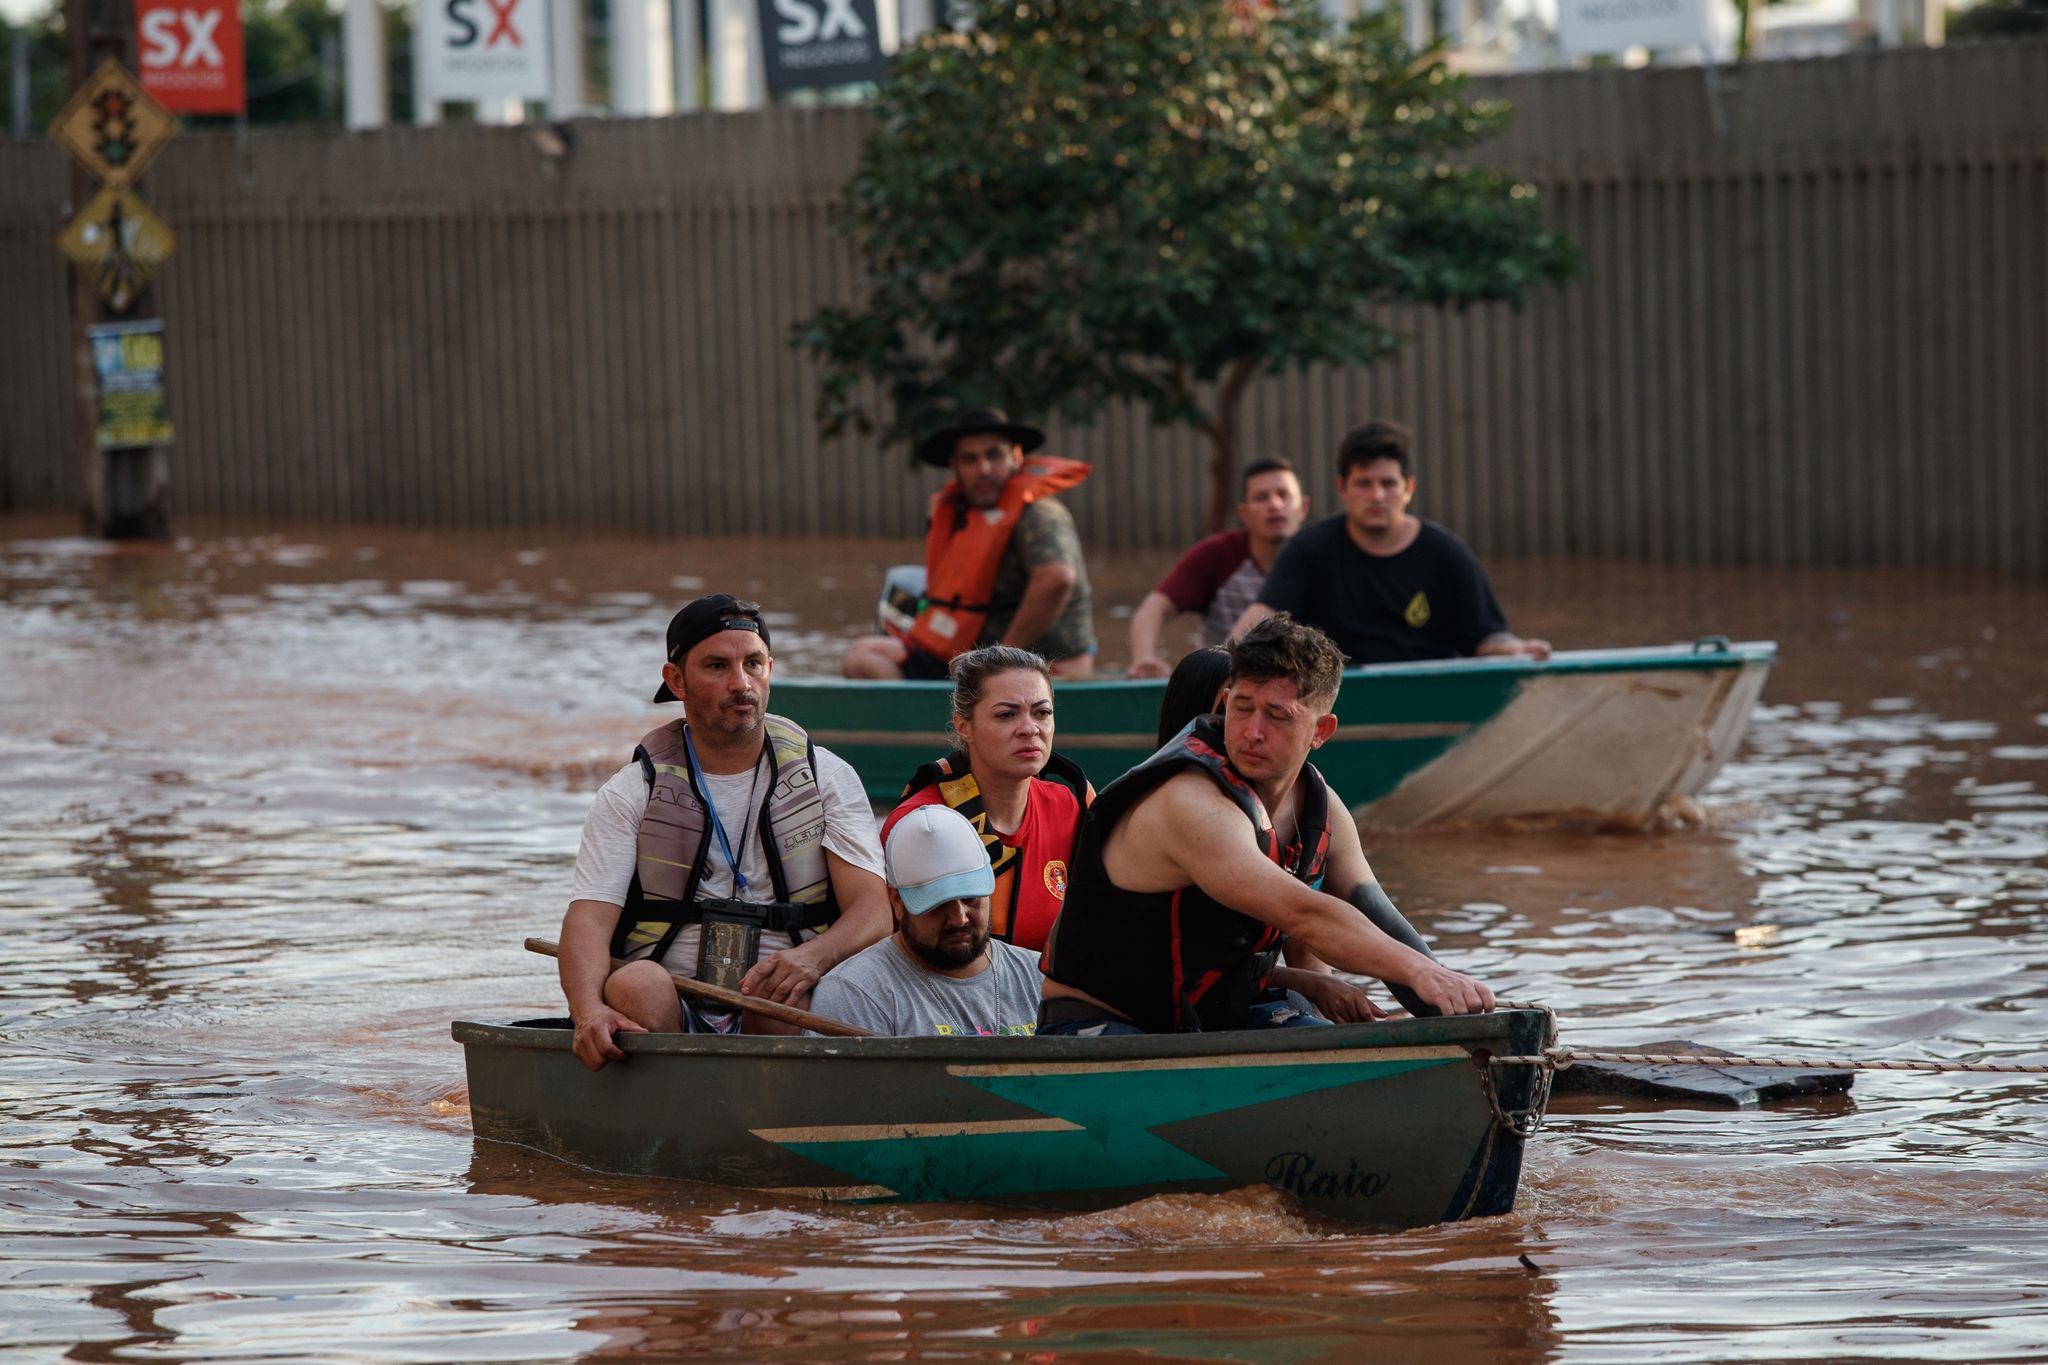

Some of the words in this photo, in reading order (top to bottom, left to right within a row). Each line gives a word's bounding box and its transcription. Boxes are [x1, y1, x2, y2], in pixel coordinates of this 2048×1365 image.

[141, 8, 223, 68] SX
[447, 0, 524, 49] SX
[777, 0, 866, 43] SX
[1265, 1152, 1391, 1198] Raio
